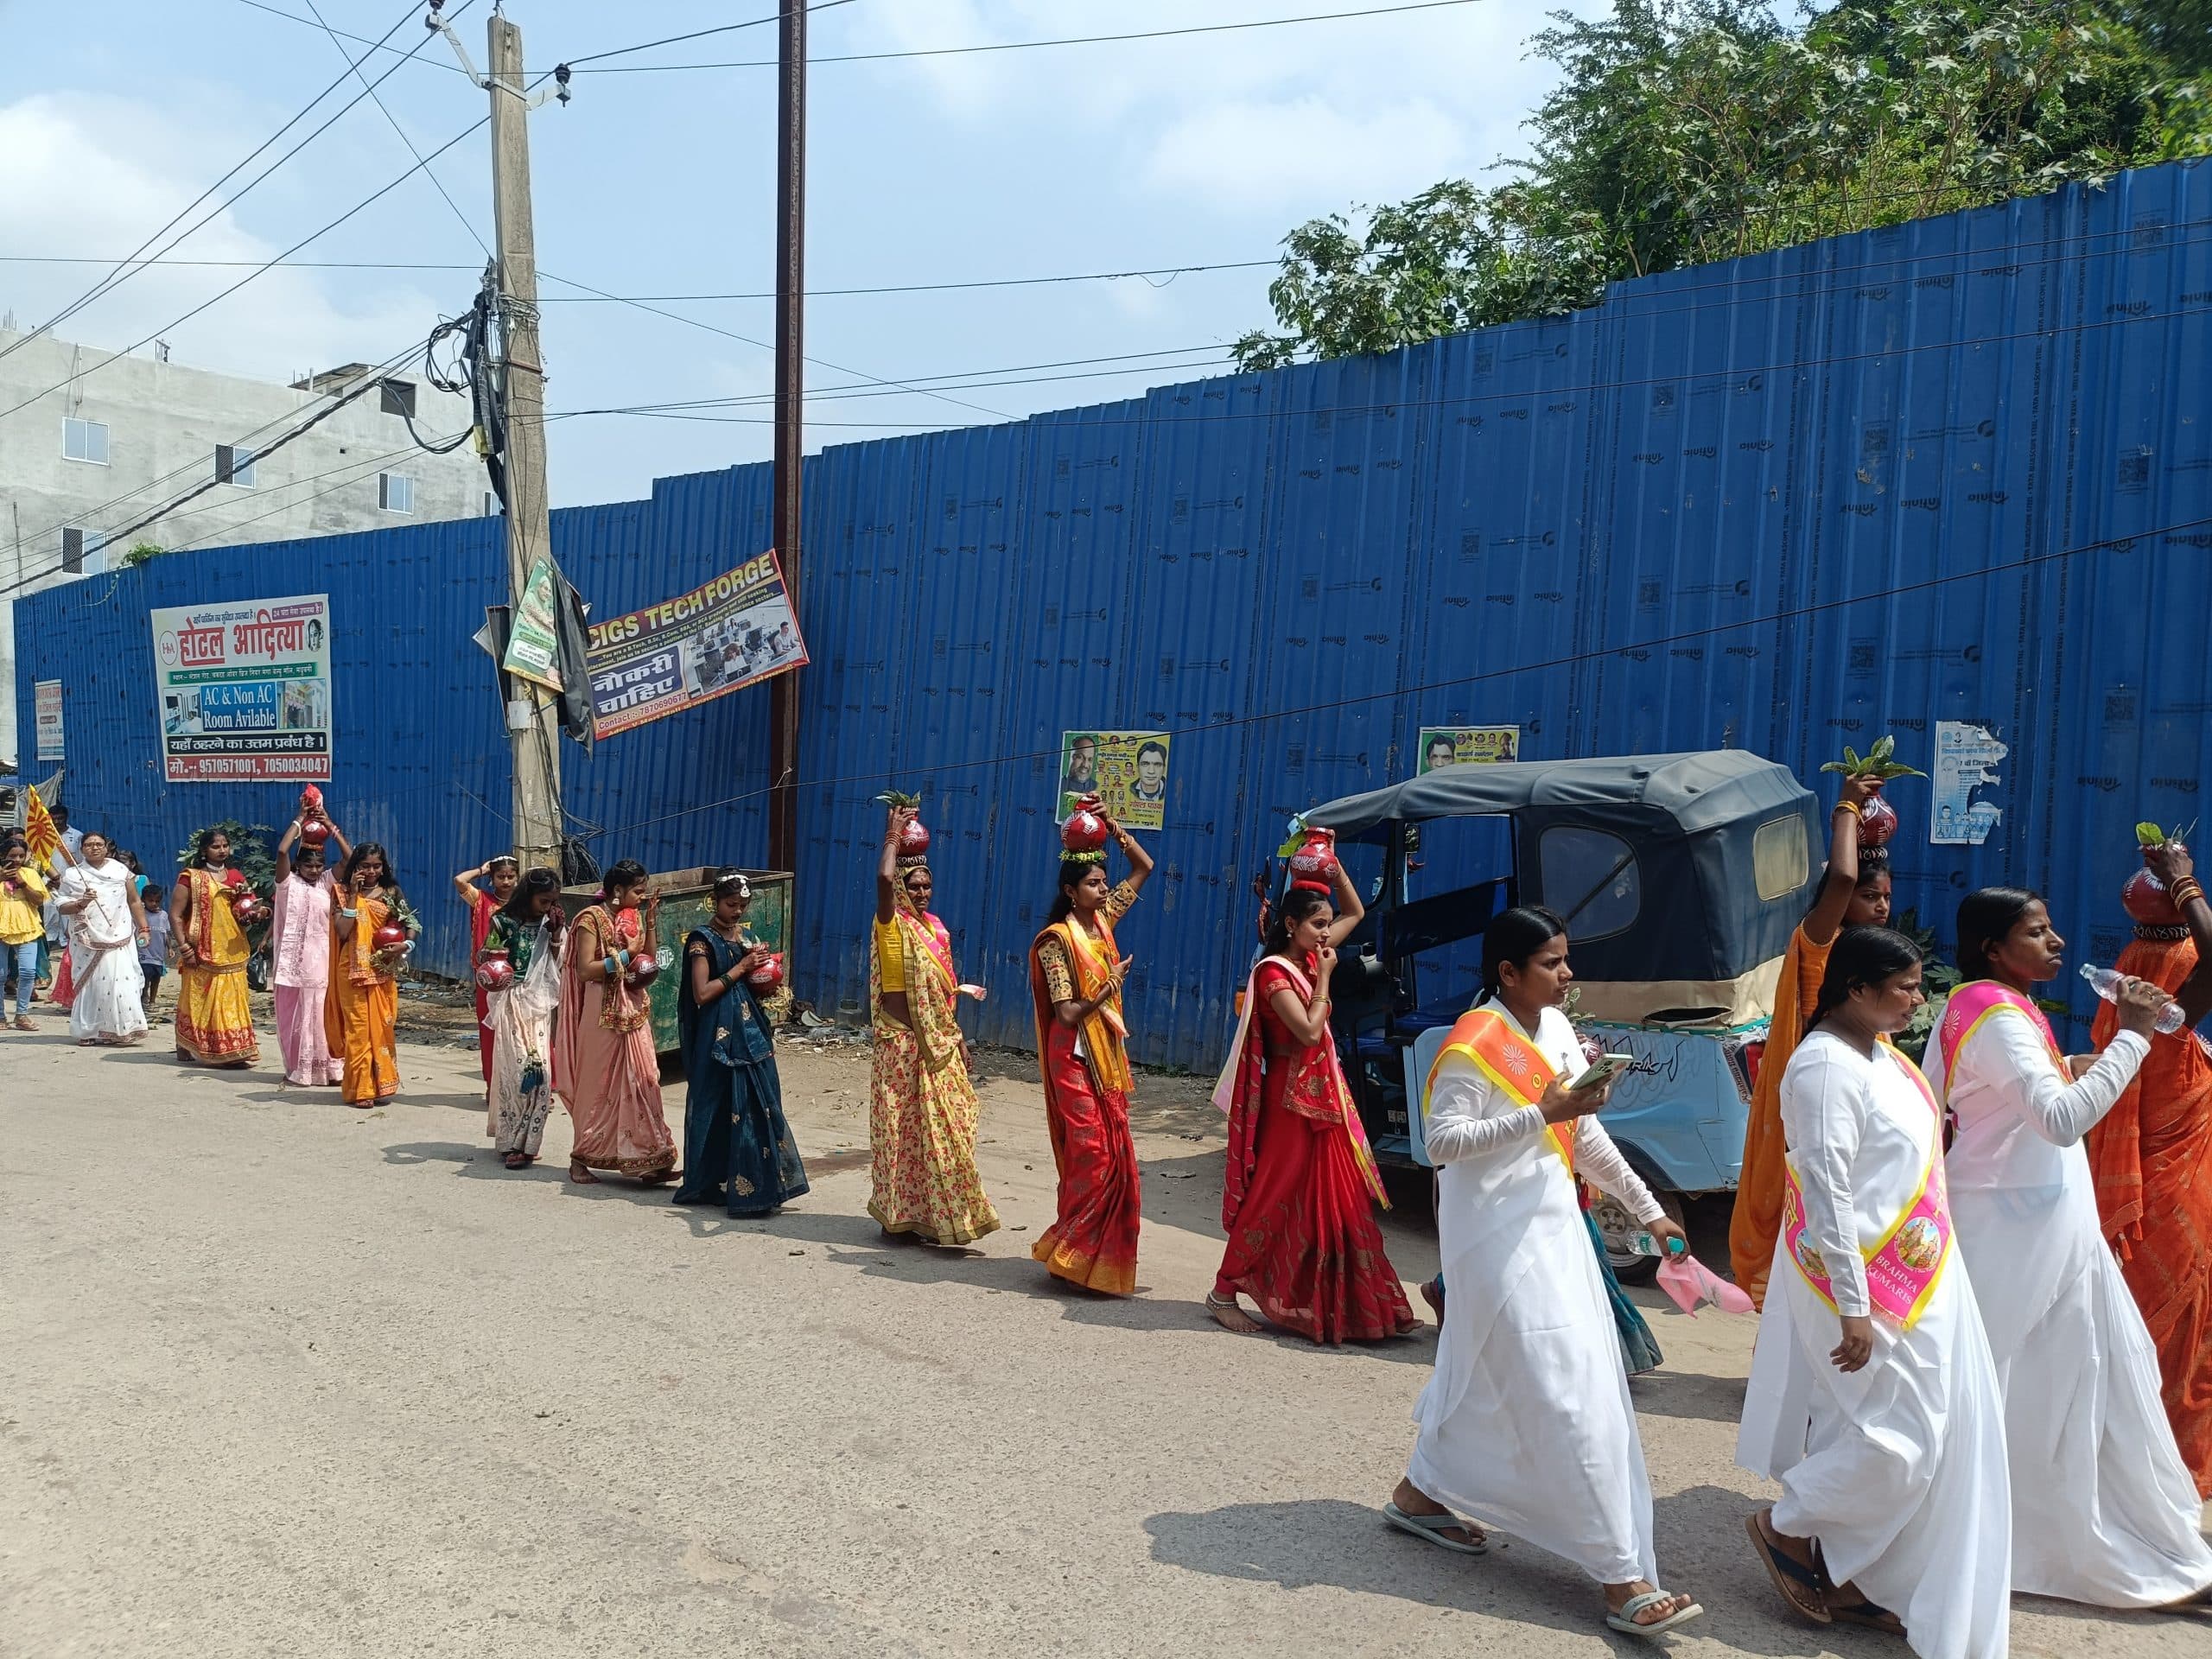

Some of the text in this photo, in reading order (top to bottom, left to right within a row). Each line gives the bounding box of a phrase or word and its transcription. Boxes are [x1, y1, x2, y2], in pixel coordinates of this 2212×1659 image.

[645, 590, 704, 629] TECH
[705, 553, 774, 607] FORGE
[178, 608, 304, 666] होटल आदित्या
[593, 653, 675, 692] नौकरी
[205, 684, 272, 705] AC & Non AC
[598, 676, 674, 714] चाहिए
[600, 713, 631, 729] Contact
[639, 692, 687, 715] 7870690677
[203, 708, 275, 728] Room Avilable
[170, 738, 192, 751] यहाँ
[194, 737, 225, 750] ठहरने
[226, 739, 244, 749] का
[245, 738, 273, 749] उत्तम
[275, 734, 303, 750] प्रबंध
[264, 757, 328, 774] 7050034047
[1866, 1264, 1913, 1305] KUMARIS
[1875, 1255, 1918, 1294] BRAHMA
